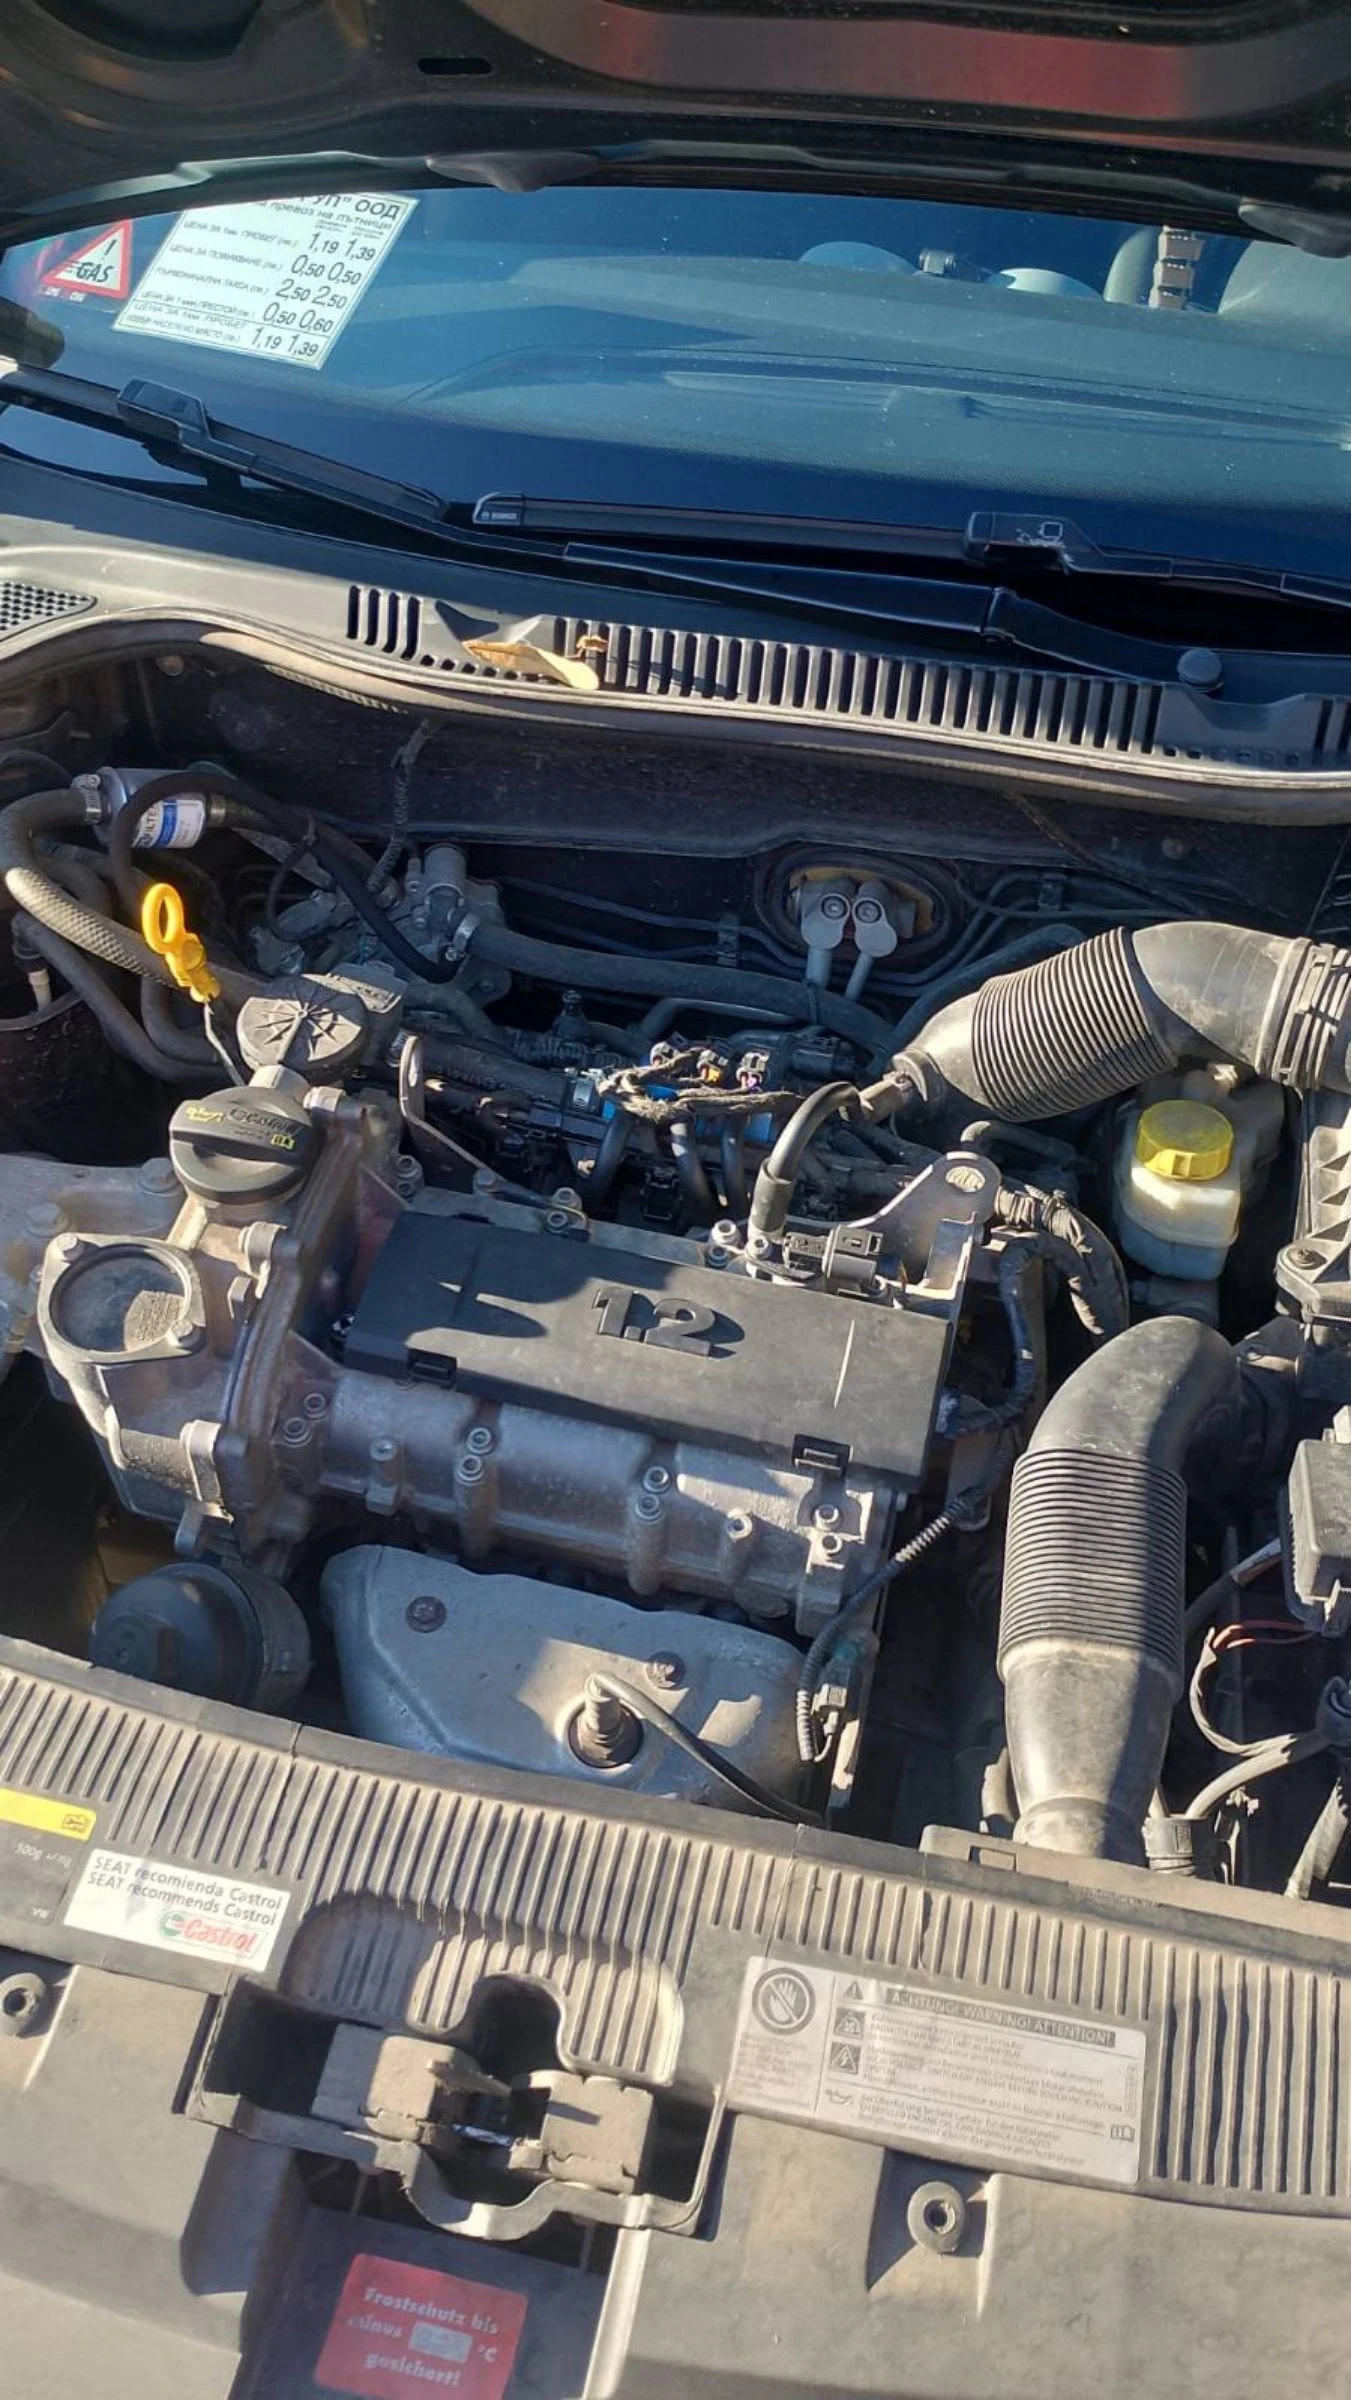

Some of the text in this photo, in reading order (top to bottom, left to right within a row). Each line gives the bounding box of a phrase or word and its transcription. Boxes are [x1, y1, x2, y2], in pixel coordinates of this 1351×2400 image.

[354, 199, 400, 221] ООД
[309, 232, 340, 254] 1,19
[346, 239, 376, 261] 1,39
[76, 262, 114, 283] GAS
[291, 254, 362, 285] 0,50 0,50
[276, 278, 348, 309] 2,50 2,50
[263, 302, 334, 333] 0,50 0,60
[252, 326, 319, 357] 1,19 1,39
[592, 1286, 716, 1357] 1.2
[95, 1856, 131, 1875] SEAT
[134, 1867, 224, 1897] recomienda
[229, 1887, 283, 1910] Castrol
[87, 1872, 277, 1926] SEAT recommends Castrol
[183, 1917, 258, 1952] Castrol
[891, 1991, 1112, 2044] ACHTUNG! WARNING! ATTENTION!
[364, 2287, 499, 2334] Frostschutz bis
